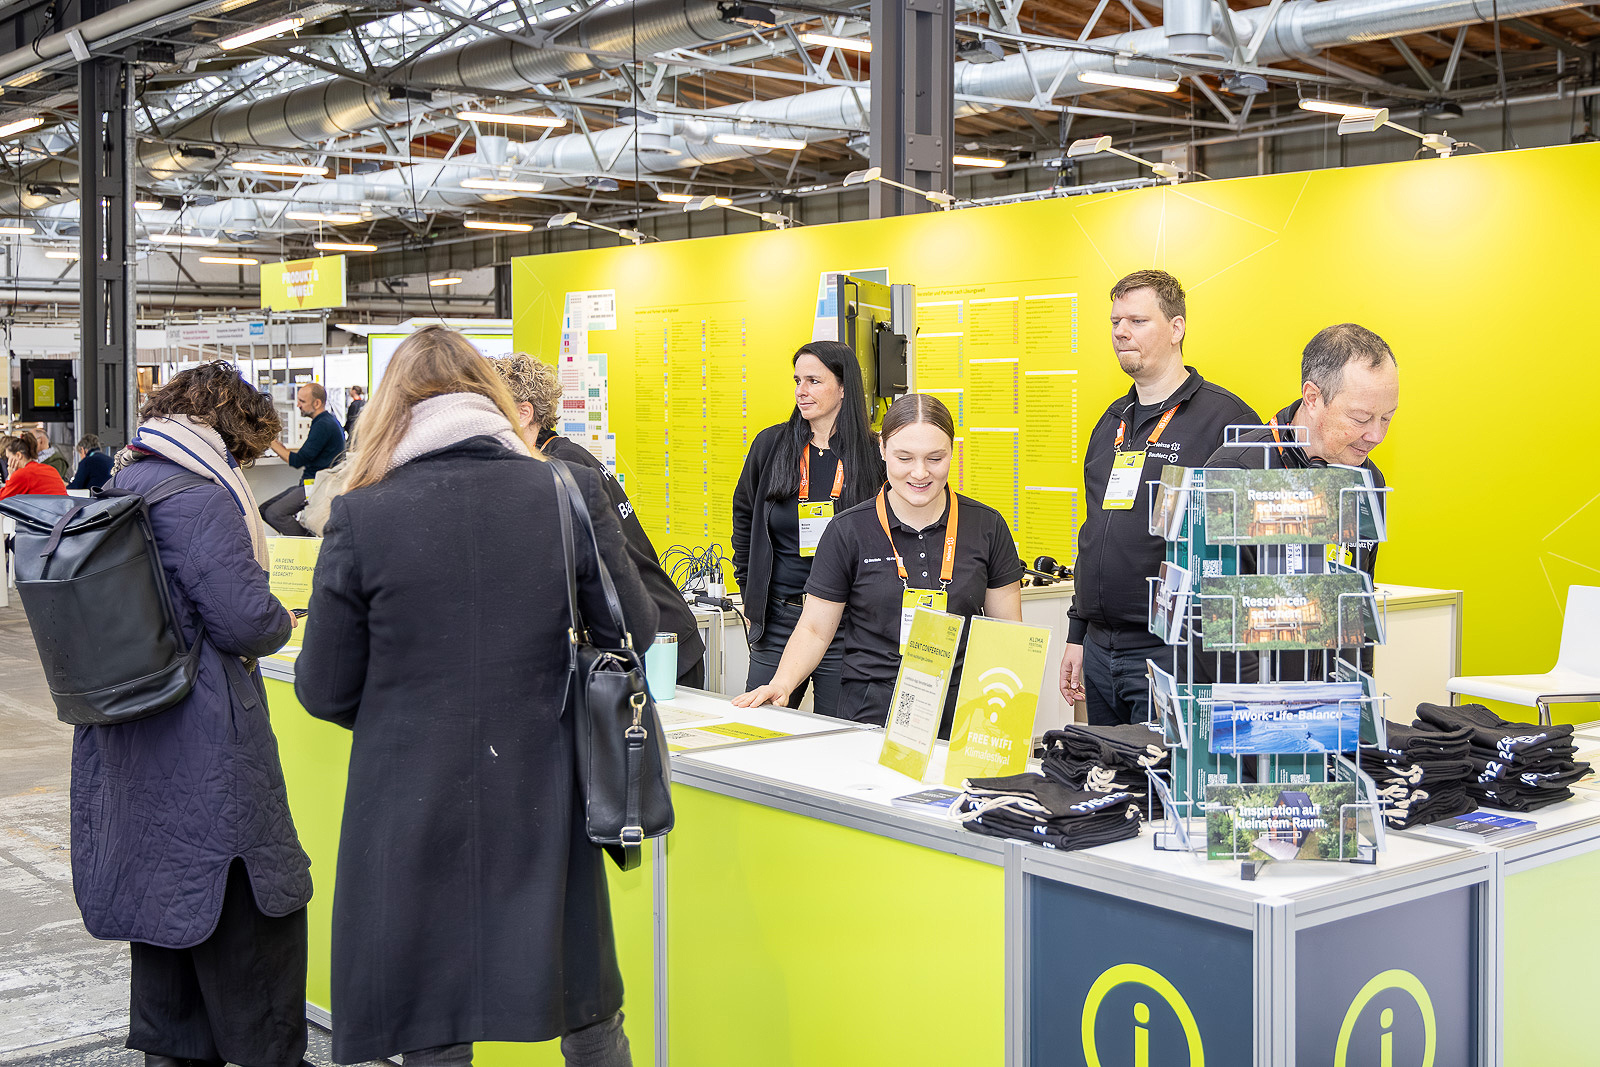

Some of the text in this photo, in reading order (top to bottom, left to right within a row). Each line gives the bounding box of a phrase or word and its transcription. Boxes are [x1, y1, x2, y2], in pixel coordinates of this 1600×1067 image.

[282, 268, 319, 284] PRODUKT &
[287, 284, 314, 298] UMWELT
[1248, 490, 1313, 500] Ressourcen
[1256, 502, 1308, 513] schonen.
[1242, 596, 1306, 607] Ressourcen
[1251, 608, 1302, 620] schonen.
[910, 640, 922, 649] SILENT
[922, 644, 951, 658] CONFERENCING
[1231, 710, 1342, 721] #Work-Life-Balance
[968, 732, 1012, 750] FREE WIFI
[965, 746, 1010, 765] Klimafestival
[1240, 805, 1321, 818] Inspiration auf
[1235, 817, 1328, 829] kleinstem Raum.
